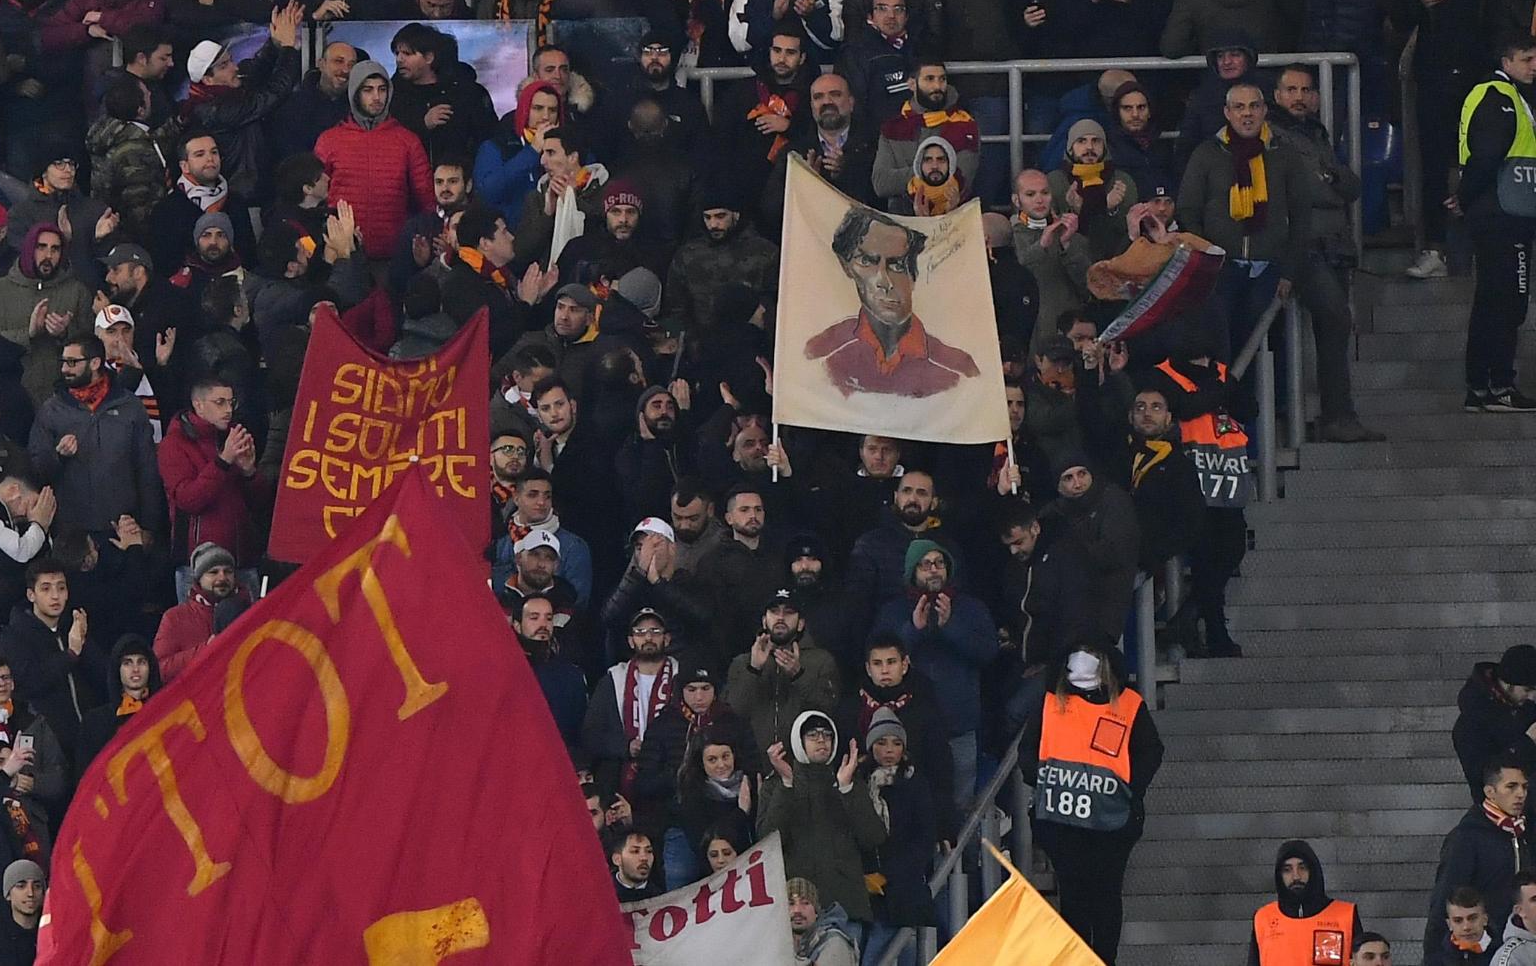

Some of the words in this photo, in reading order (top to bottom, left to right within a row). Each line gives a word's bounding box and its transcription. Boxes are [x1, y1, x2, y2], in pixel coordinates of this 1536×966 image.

[1517, 251, 1528, 294] umbro
[303, 400, 318, 443] I
[324, 407, 466, 462] SOLITI
[1045, 788, 1092, 819] 188
